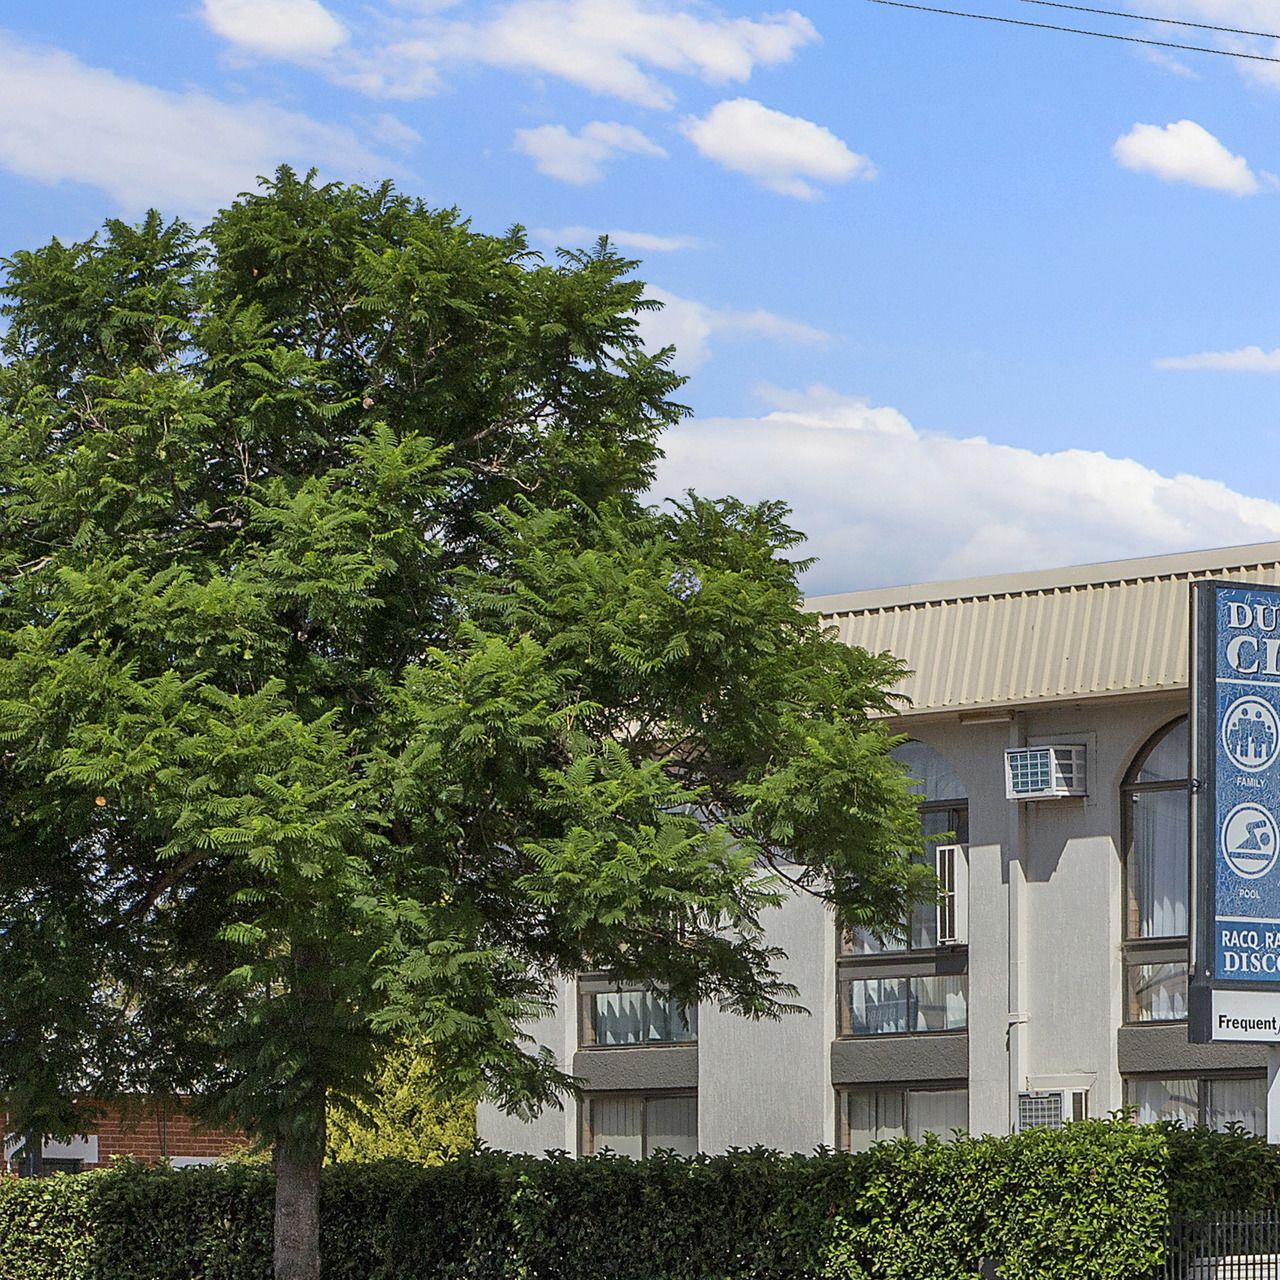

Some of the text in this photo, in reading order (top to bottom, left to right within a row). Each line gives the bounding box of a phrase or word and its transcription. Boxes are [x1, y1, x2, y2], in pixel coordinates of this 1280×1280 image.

[1236, 777, 1265, 787] FAMILY
[1239, 889, 1260, 899] POOL
[1222, 930, 1260, 950] RACQ
